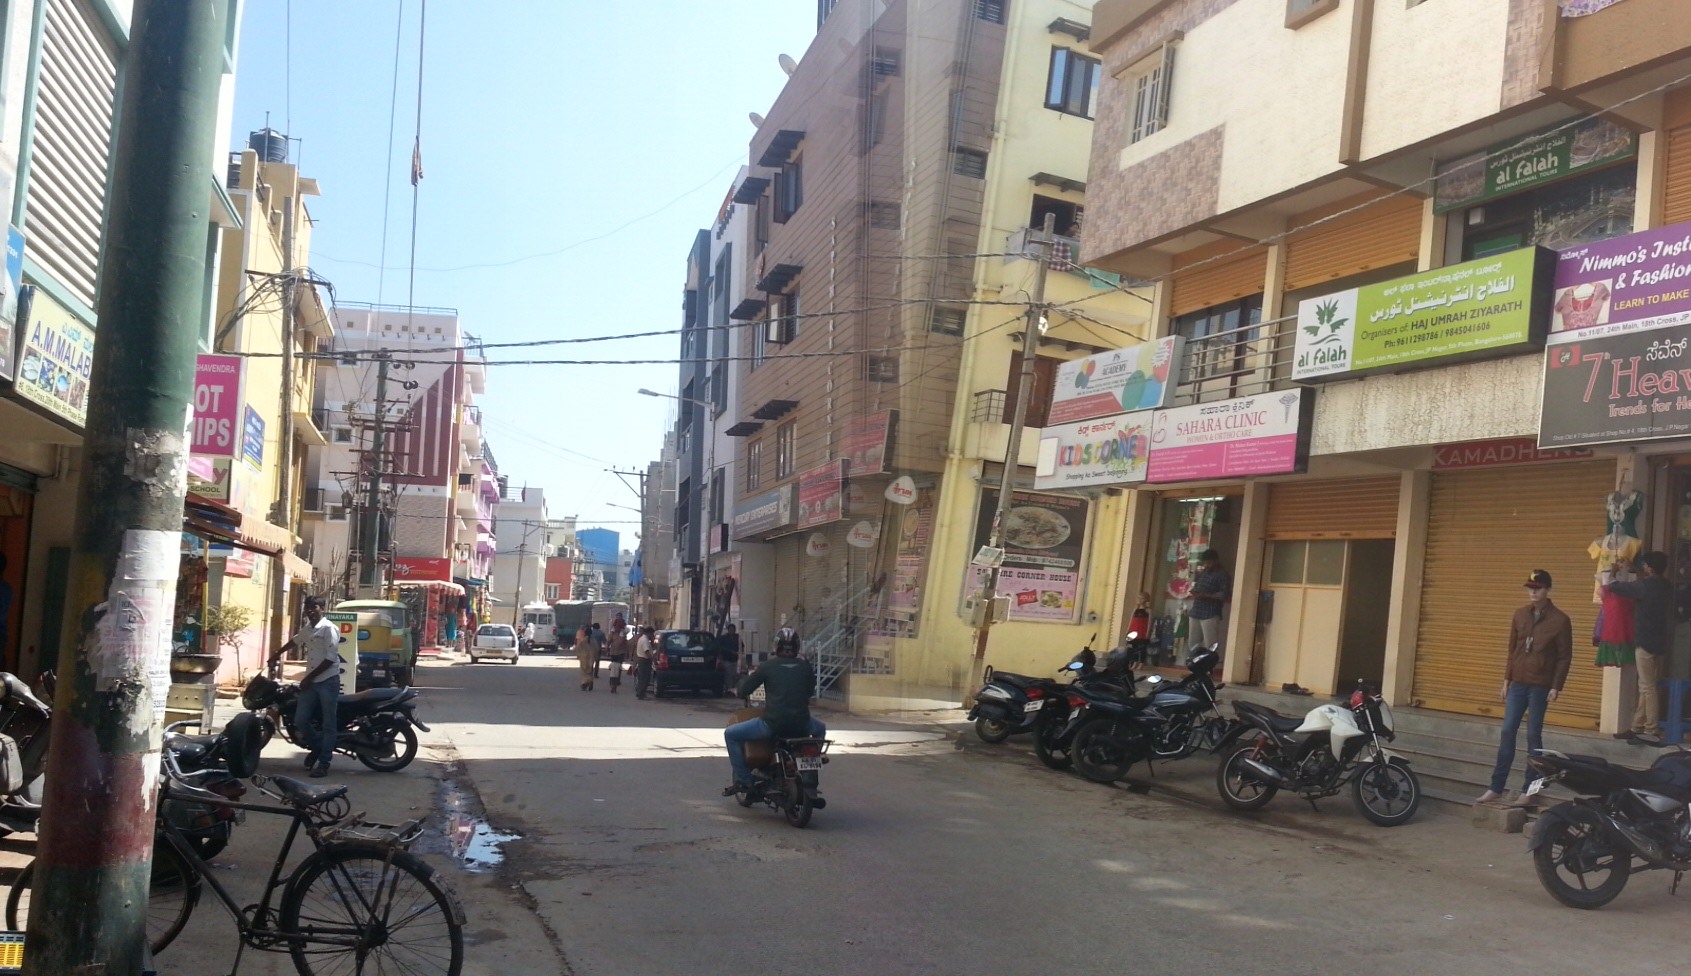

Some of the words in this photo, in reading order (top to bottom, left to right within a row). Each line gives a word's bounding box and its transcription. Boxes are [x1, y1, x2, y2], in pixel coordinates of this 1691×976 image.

[1496, 169, 1511, 185] al
[1516, 153, 1559, 179] falah
[1496, 175, 1537, 191] INTERNATIONAL
[1539, 168, 1558, 178] TOURS
[1579, 244, 1647, 274] Nimmo's
[1614, 274, 1626, 289] &
[1614, 295, 1646, 311] LEARN
[1647, 293, 1660, 305] TO
[1661, 287, 1690, 303] MAKE
[1361, 324, 1401, 341] Organisers
[1411, 317, 1430, 332] HAJ
[1431, 311, 1467, 326] UMRAH
[1469, 300, 1523, 319] ZIYARATH
[1656, 316, 1677, 328] Cross,
[1679, 312, 1690, 322] JP
[1297, 353, 1309, 368] al
[1313, 346, 1347, 365] falah
[1102, 363, 1127, 375] ACADEMY
[1608, 402, 1647, 418] Trends
[1652, 398, 1671, 412] for
[1176, 416, 1222, 436] SAHARA
[1225, 410, 1268, 429] CLINIC
[1186, 434, 1208, 444] WOMEN
[1214, 430, 1235, 441] ORTHO
[1236, 429, 1252, 439] CARE
[1059, 443, 1093, 467] KIDS
[1095, 434, 1148, 464] CORNER
[190, 485, 221, 493] SCHOOL
[1017, 571, 1046, 582] CORNER
[1049, 573, 1072, 583] HOUSE
[324, 613, 354, 621] VINAYAKA
